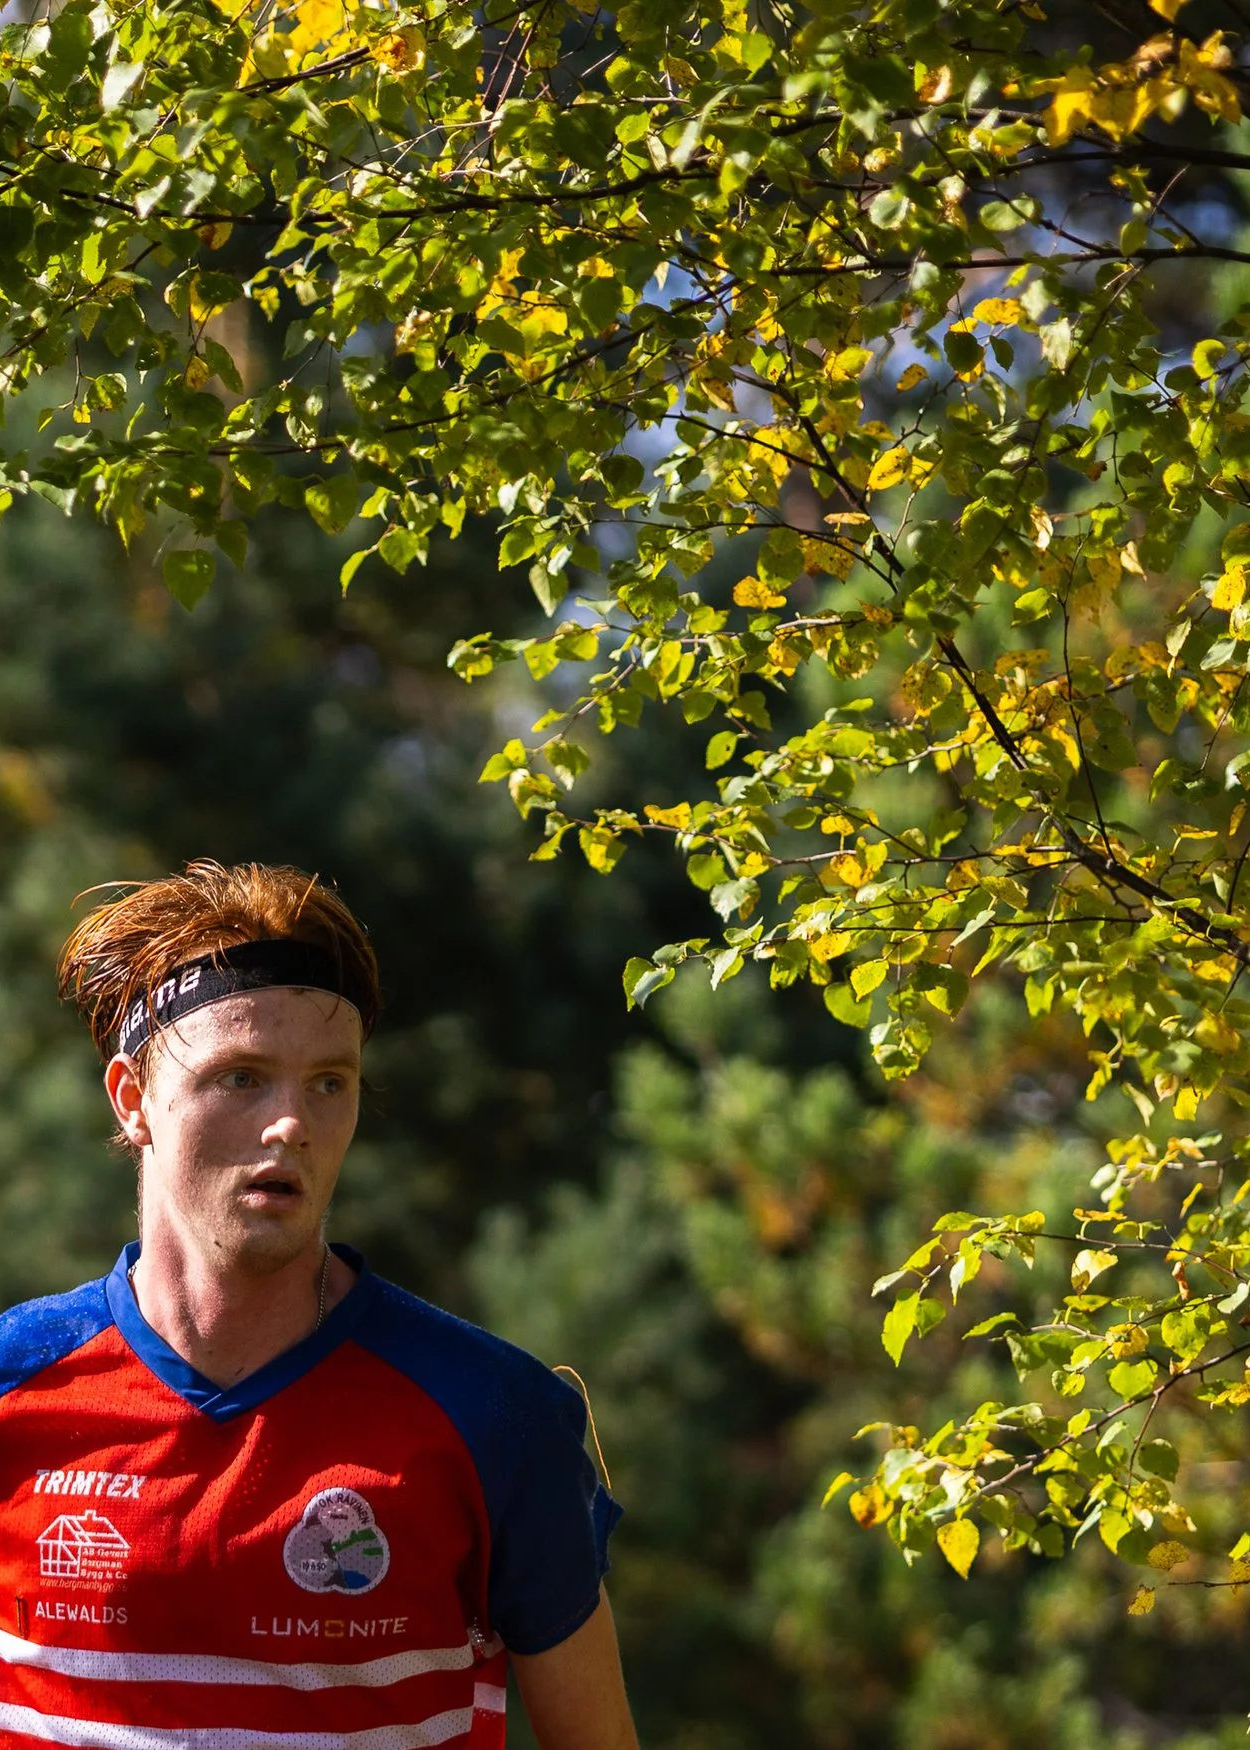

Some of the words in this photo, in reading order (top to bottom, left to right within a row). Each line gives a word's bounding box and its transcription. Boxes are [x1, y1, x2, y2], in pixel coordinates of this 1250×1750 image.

[33, 1469, 147, 1499] TRIMTEX
[319, 1494, 333, 1507] OK
[336, 1493, 370, 1525] RAVINEN
[82, 1547, 95, 1556] AB
[80, 1568, 104, 1580] Bygg
[35, 1601, 128, 1624] ALEWALDS
[251, 1616, 409, 1638] LUMONITE
